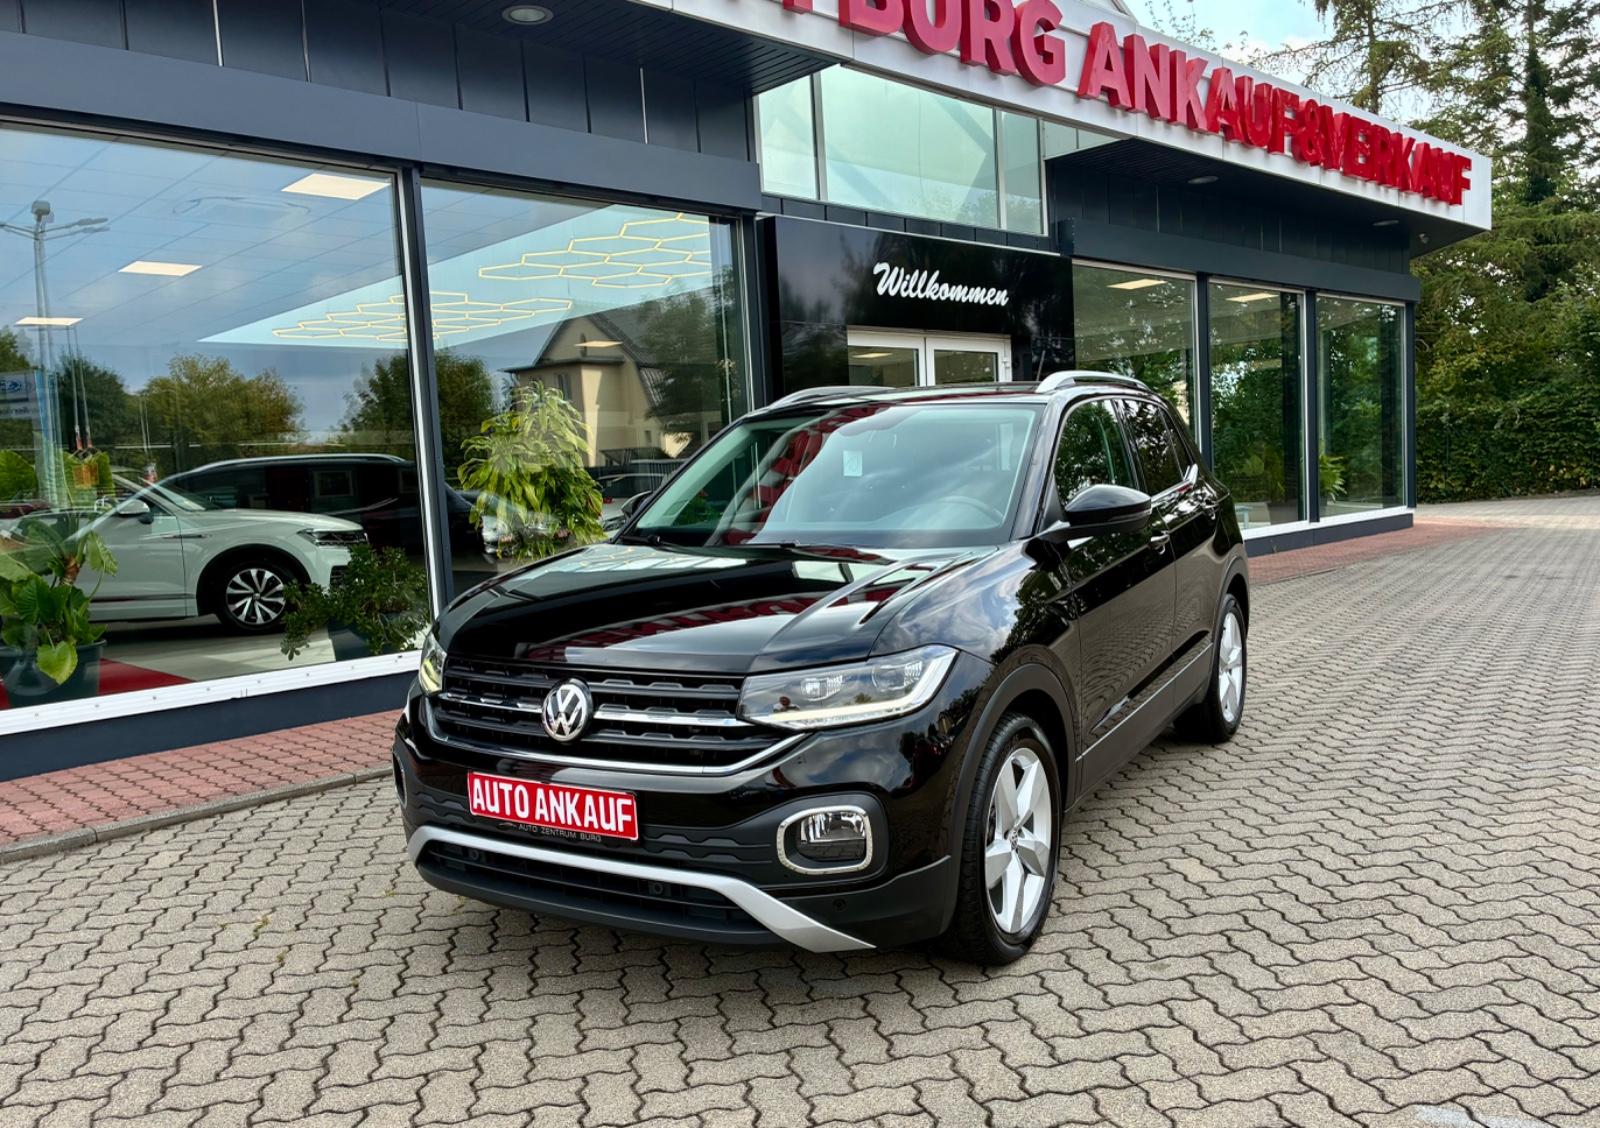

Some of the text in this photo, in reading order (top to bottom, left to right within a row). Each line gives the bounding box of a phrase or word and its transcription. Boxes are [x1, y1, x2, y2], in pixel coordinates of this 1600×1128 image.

[873, 262, 1009, 306] Willkommen
[473, 778, 632, 832] AUTO ANKAUF
[518, 823, 538, 833] AUTO
[541, 827, 577, 839] ZENTRUM
